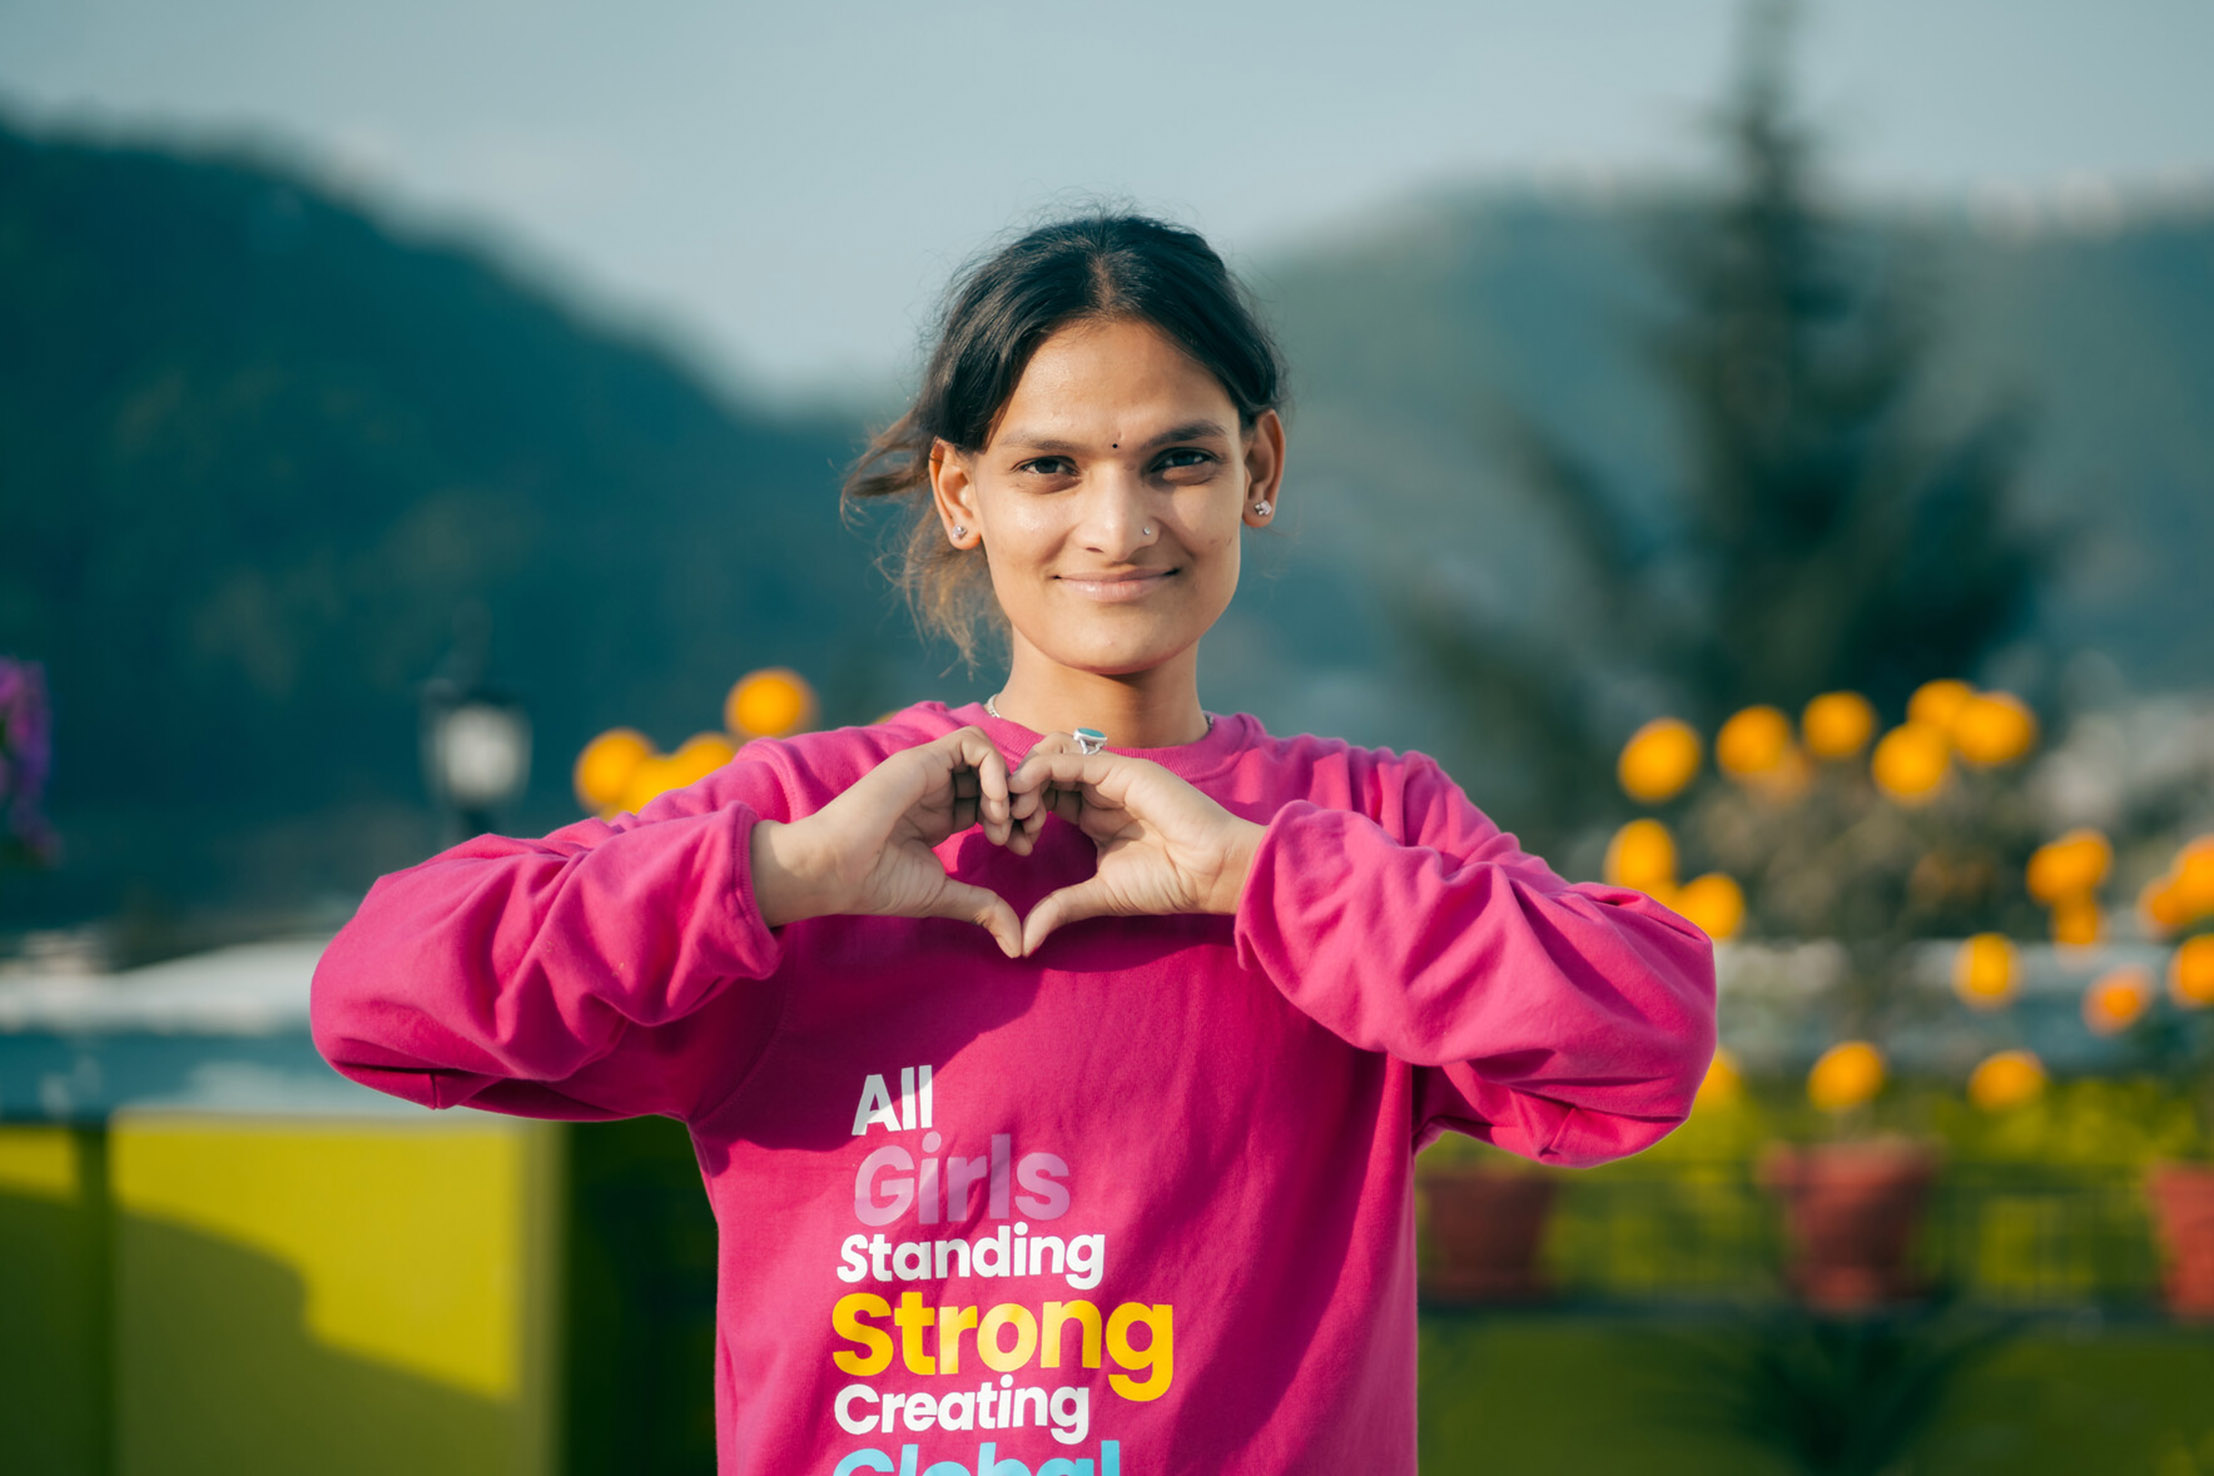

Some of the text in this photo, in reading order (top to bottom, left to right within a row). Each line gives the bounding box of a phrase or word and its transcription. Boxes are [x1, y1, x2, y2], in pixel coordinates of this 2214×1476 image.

[852, 1065, 932, 1136] All
[854, 1131, 1071, 1227] Girls
[836, 1221, 1106, 1290] Standing
[832, 1291, 1174, 1402] Strong
[834, 1374, 1089, 1445] Creating
